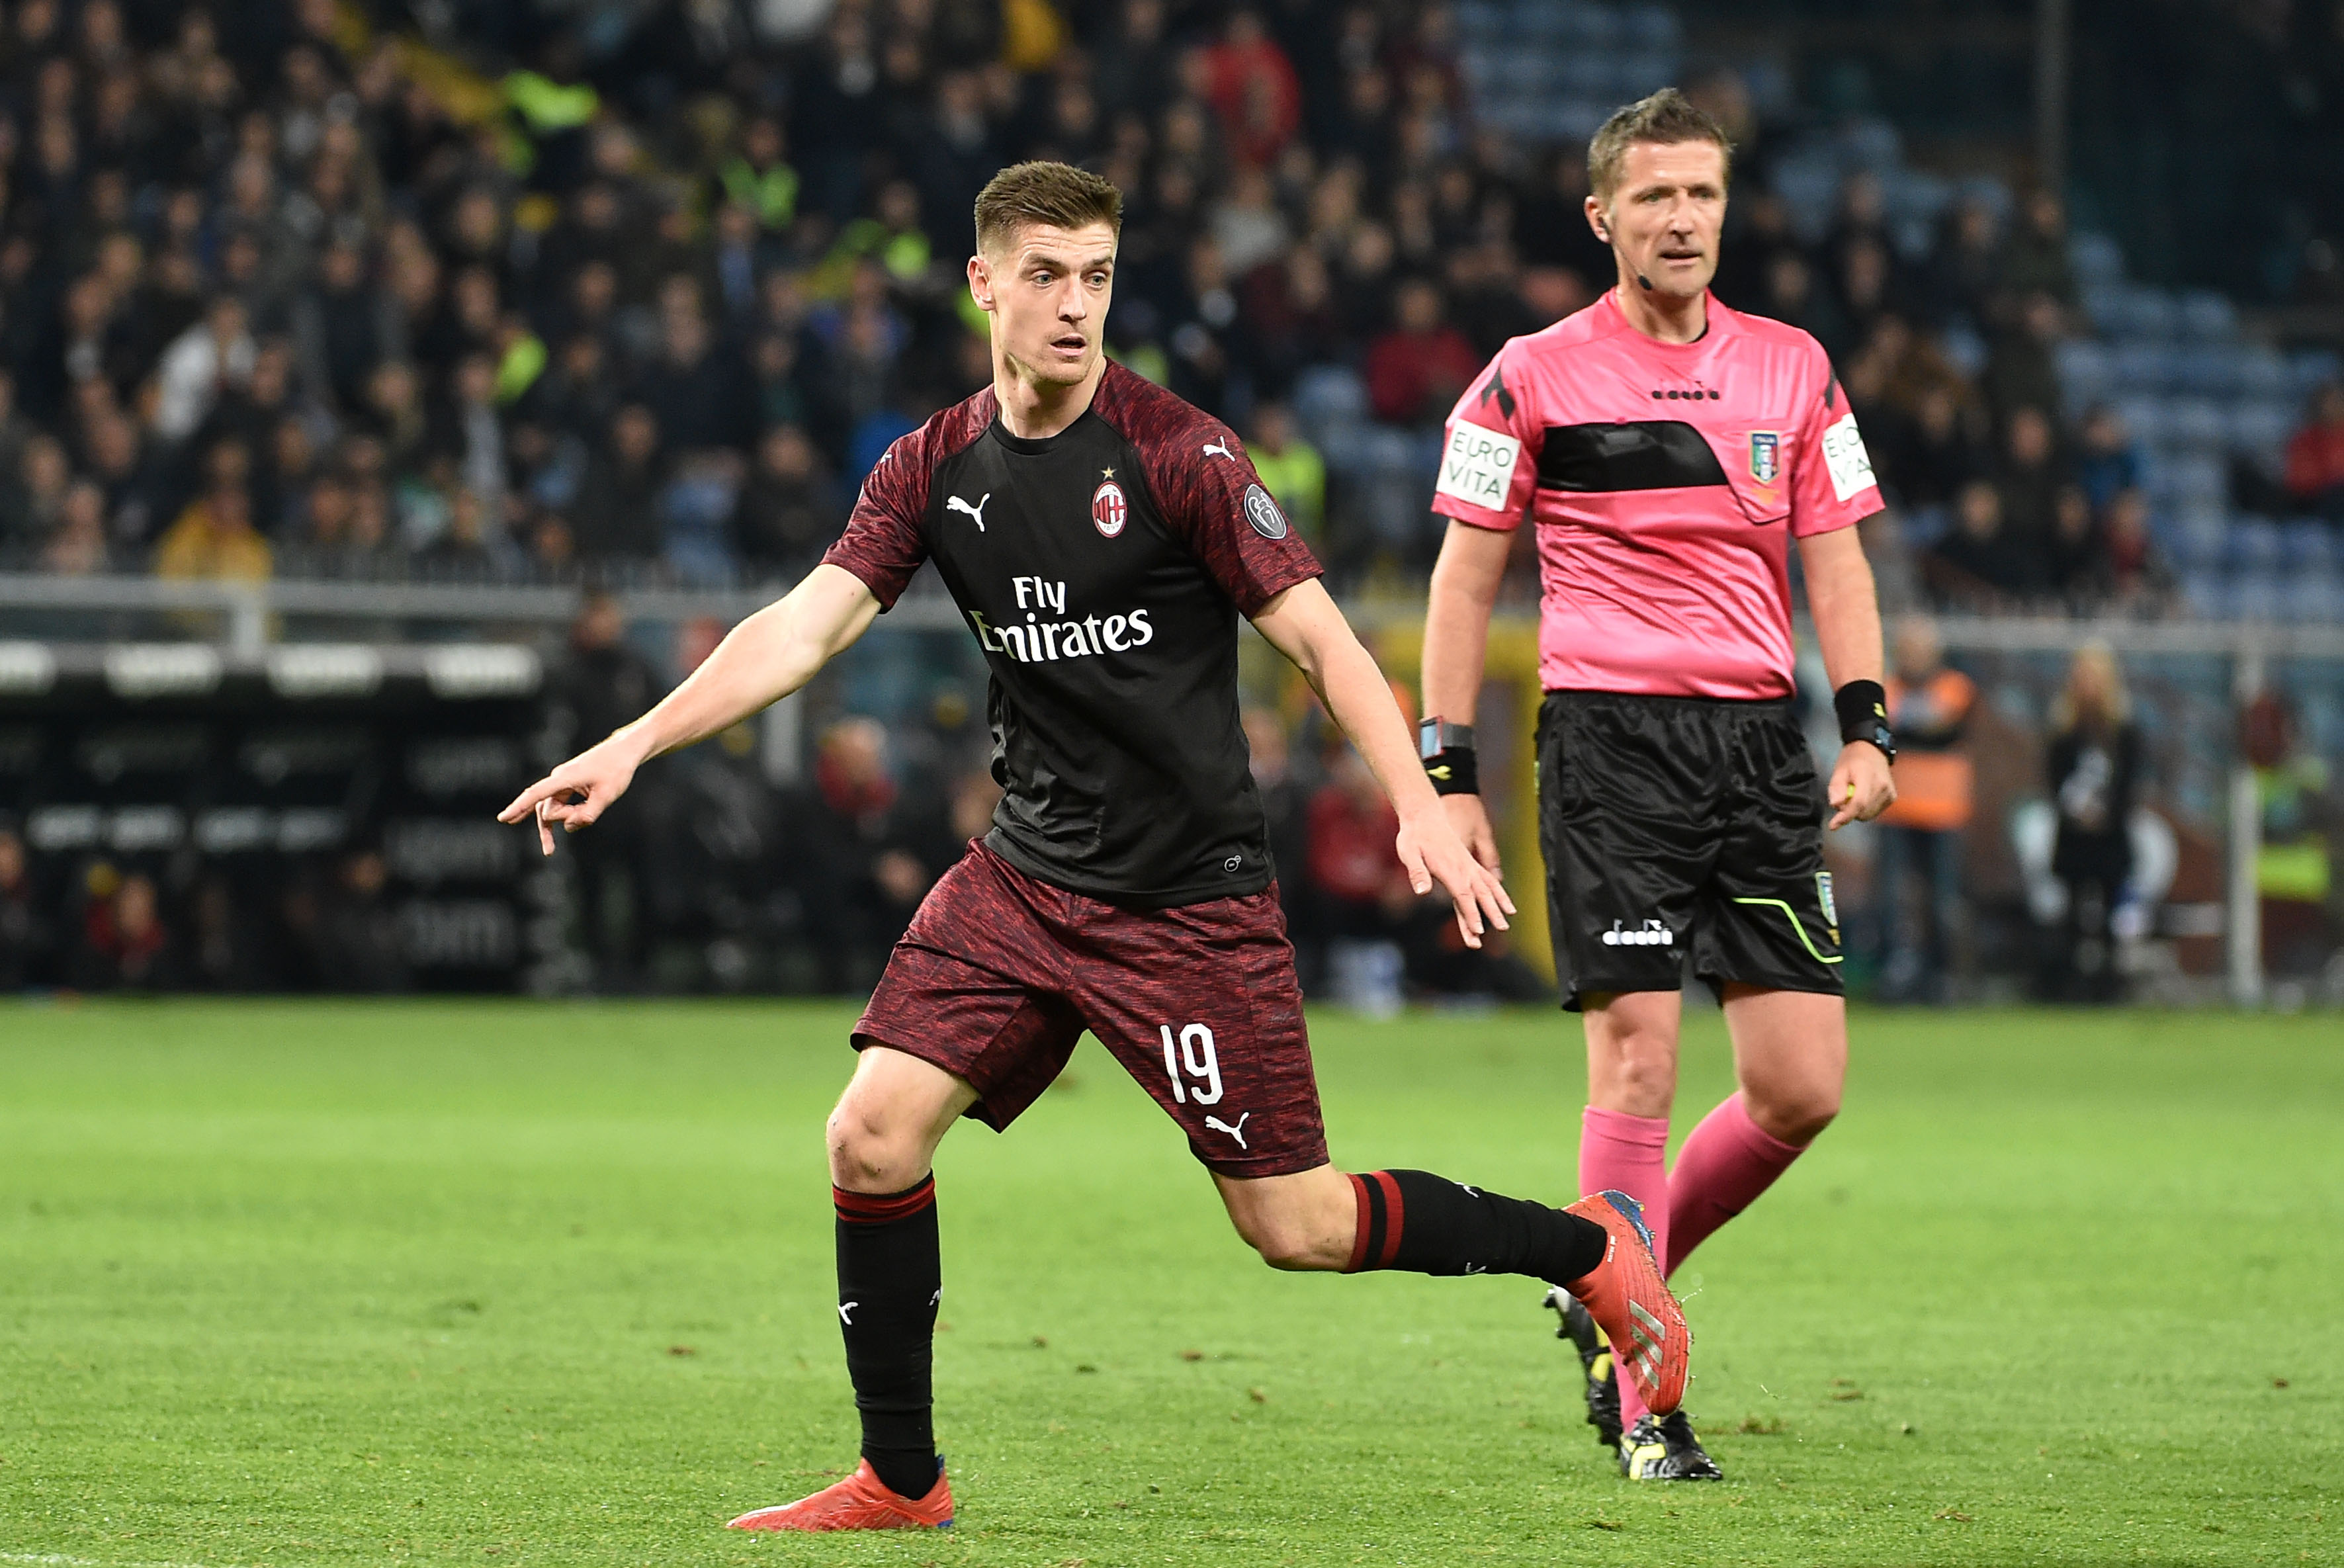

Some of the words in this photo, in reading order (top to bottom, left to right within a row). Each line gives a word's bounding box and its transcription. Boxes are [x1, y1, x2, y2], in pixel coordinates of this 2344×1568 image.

[1452, 431, 1512, 467] EURO
[1447, 457, 1502, 499] VITA
[1012, 576, 1066, 615] Fly
[969, 608, 1153, 662] Emirates
[1160, 1023, 1223, 1105] 19
